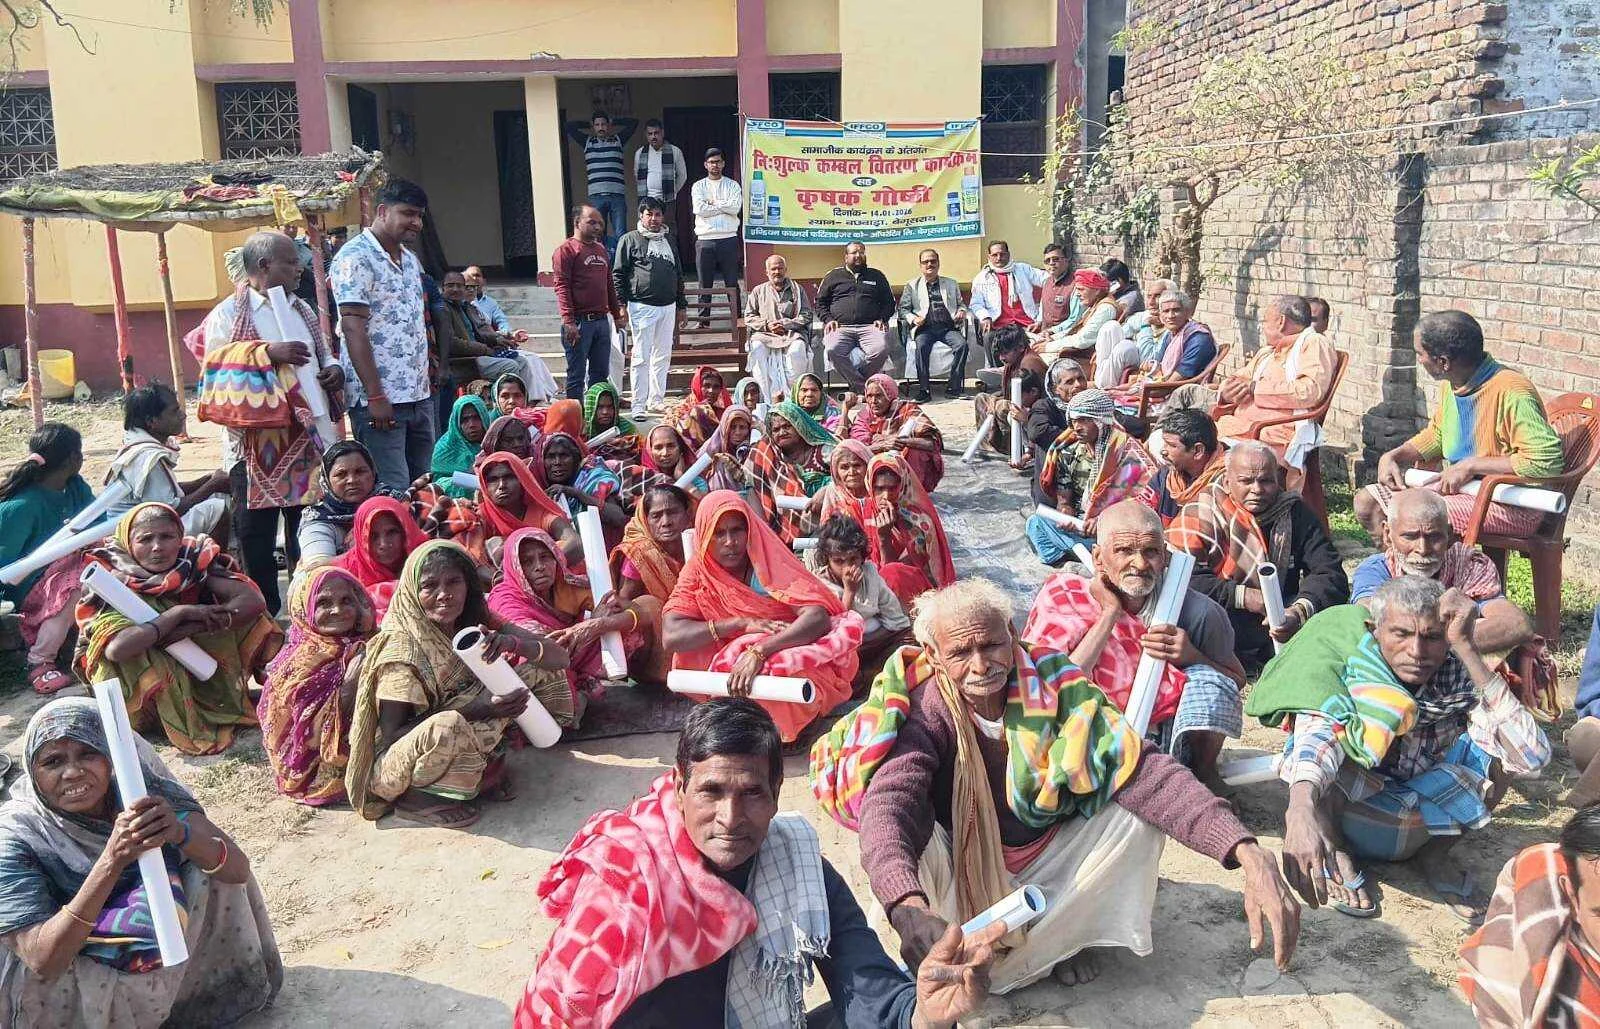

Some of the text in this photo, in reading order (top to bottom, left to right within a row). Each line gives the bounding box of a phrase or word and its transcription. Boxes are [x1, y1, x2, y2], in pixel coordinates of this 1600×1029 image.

[846, 145, 883, 156] कार्यक्रम
[885, 145, 896, 155] के
[815, 158, 863, 175] कम्बल
[868, 154, 918, 175] वितरण
[855, 178, 873, 186] सह
[795, 184, 932, 211] कृषक गोष्ठी
[871, 208, 912, 217] 14.01.2026
